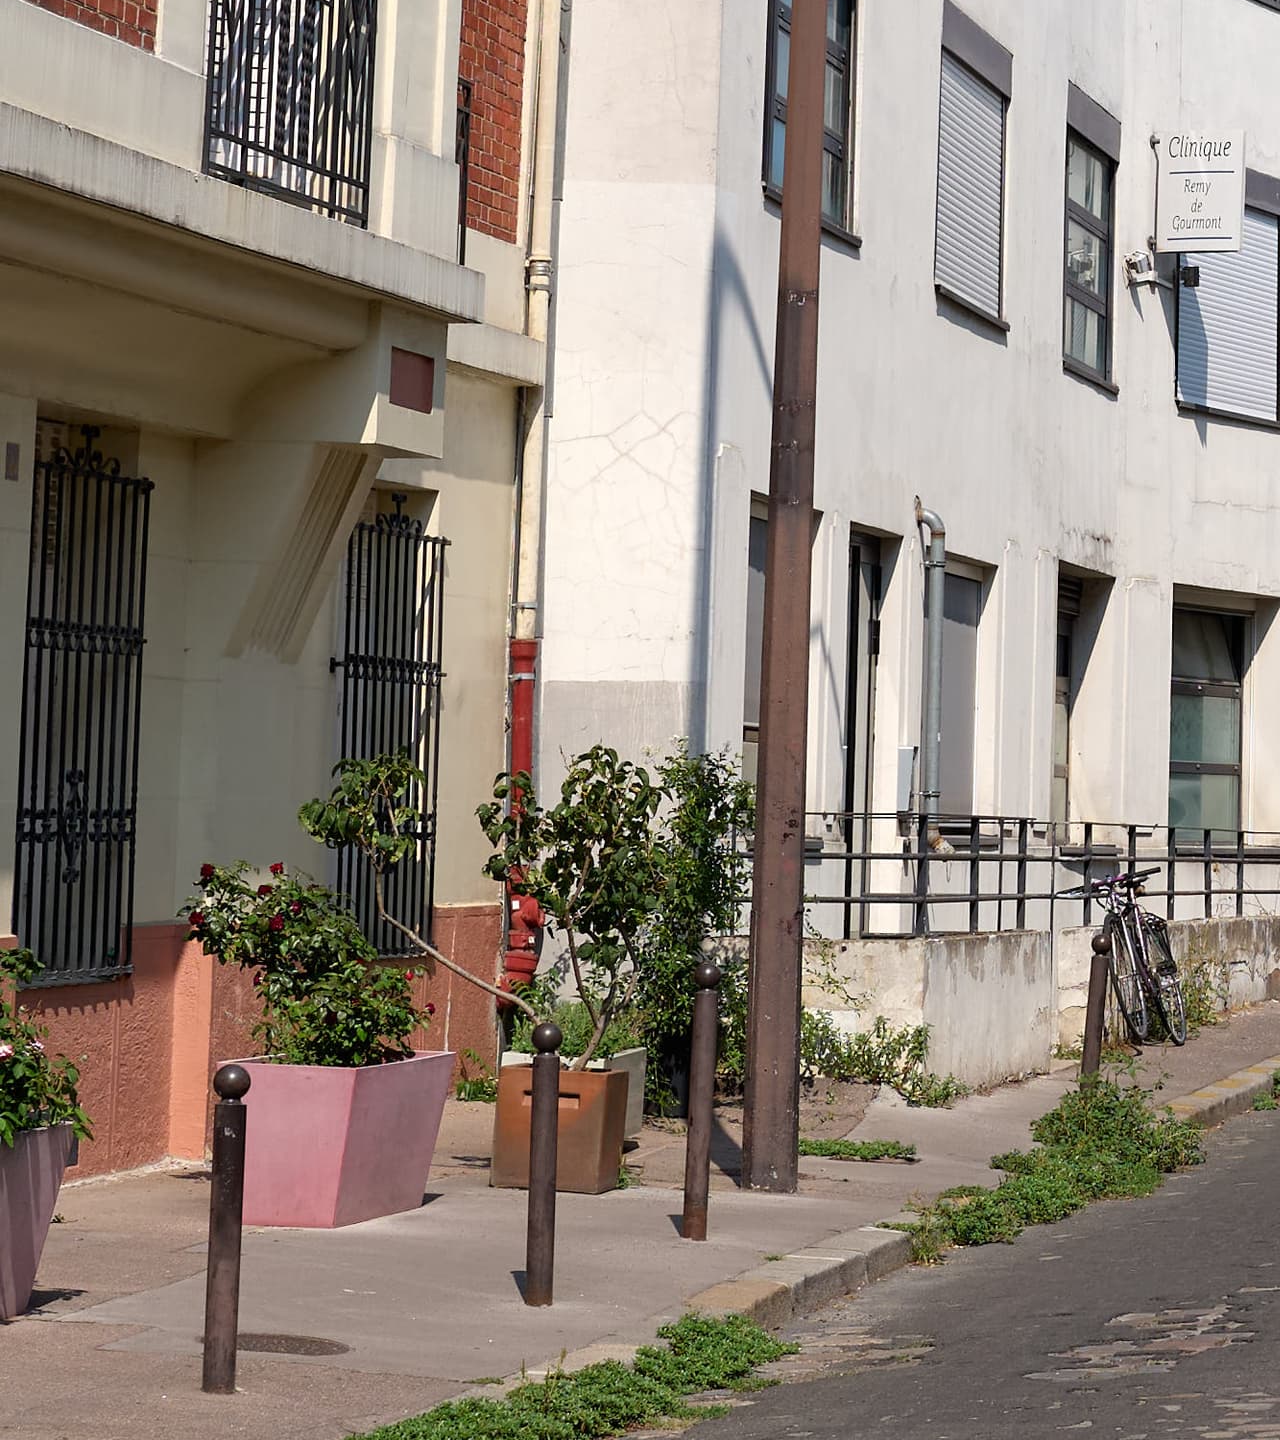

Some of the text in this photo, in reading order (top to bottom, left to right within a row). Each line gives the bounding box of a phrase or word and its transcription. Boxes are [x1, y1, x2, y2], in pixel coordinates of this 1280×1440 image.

[1168, 135, 1232, 162] Clinique
[1183, 178, 1212, 195] Remy
[1190, 199, 1203, 213] de
[1172, 215, 1222, 233] Gourmont
